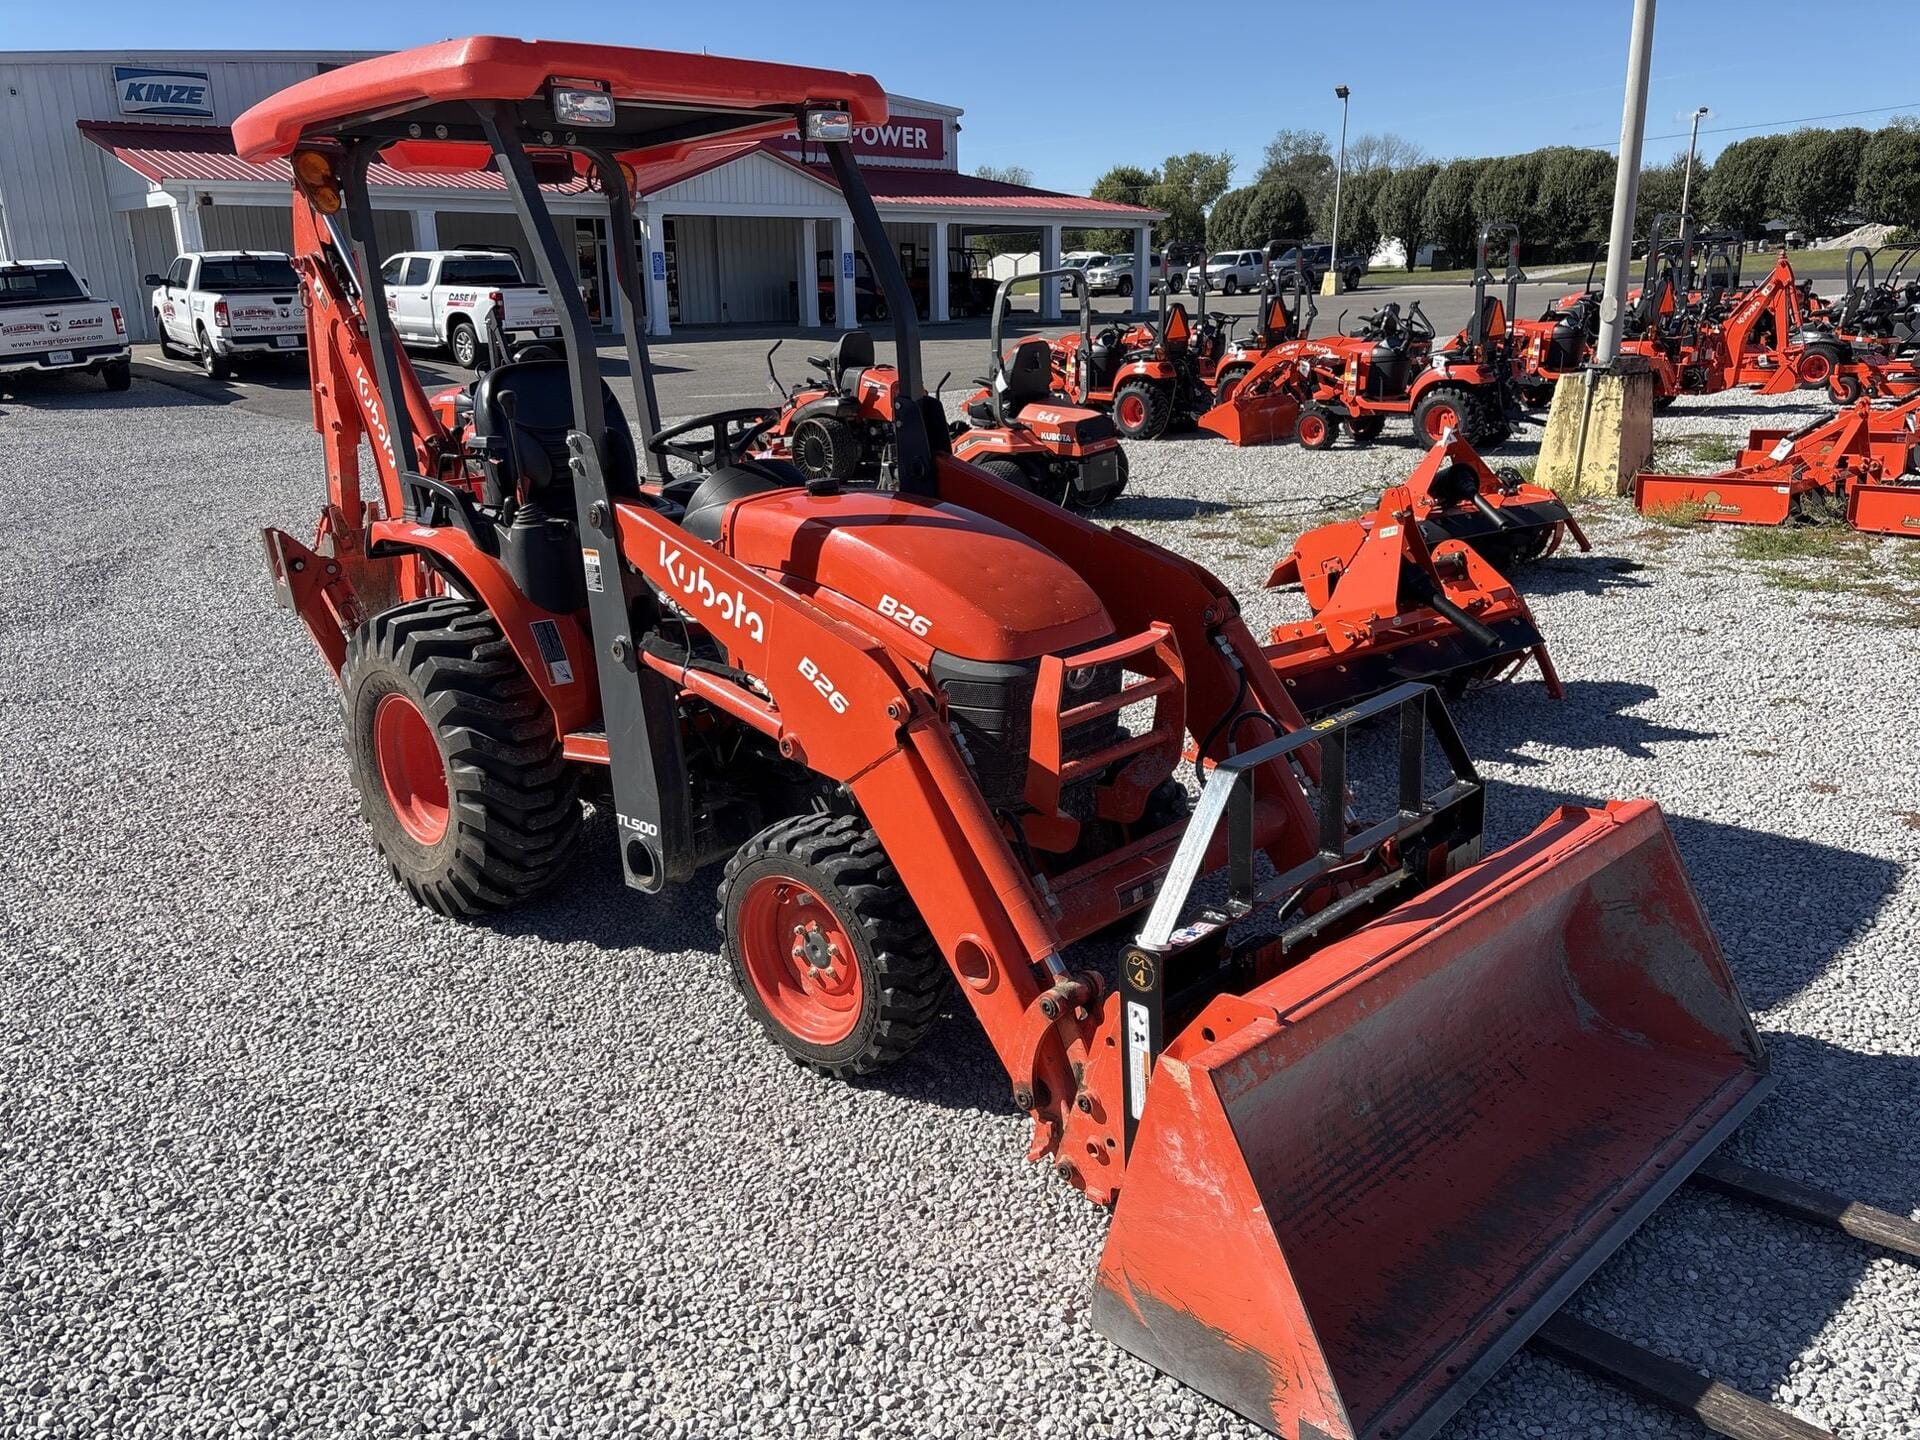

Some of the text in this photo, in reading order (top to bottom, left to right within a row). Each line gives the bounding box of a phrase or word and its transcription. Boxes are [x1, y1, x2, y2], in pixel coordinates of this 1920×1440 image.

[125, 83, 205, 104] KINZE
[449, 293, 469, 301] CASE
[11, 334, 103, 348] www.hragripower.com
[356, 366, 396, 469] Kubota
[1041, 431, 1071, 443] KUBOTA
[659, 540, 764, 644] Kubota
[877, 594, 933, 637] B26
[797, 656, 850, 714] B26
[616, 813, 657, 836] TL500
